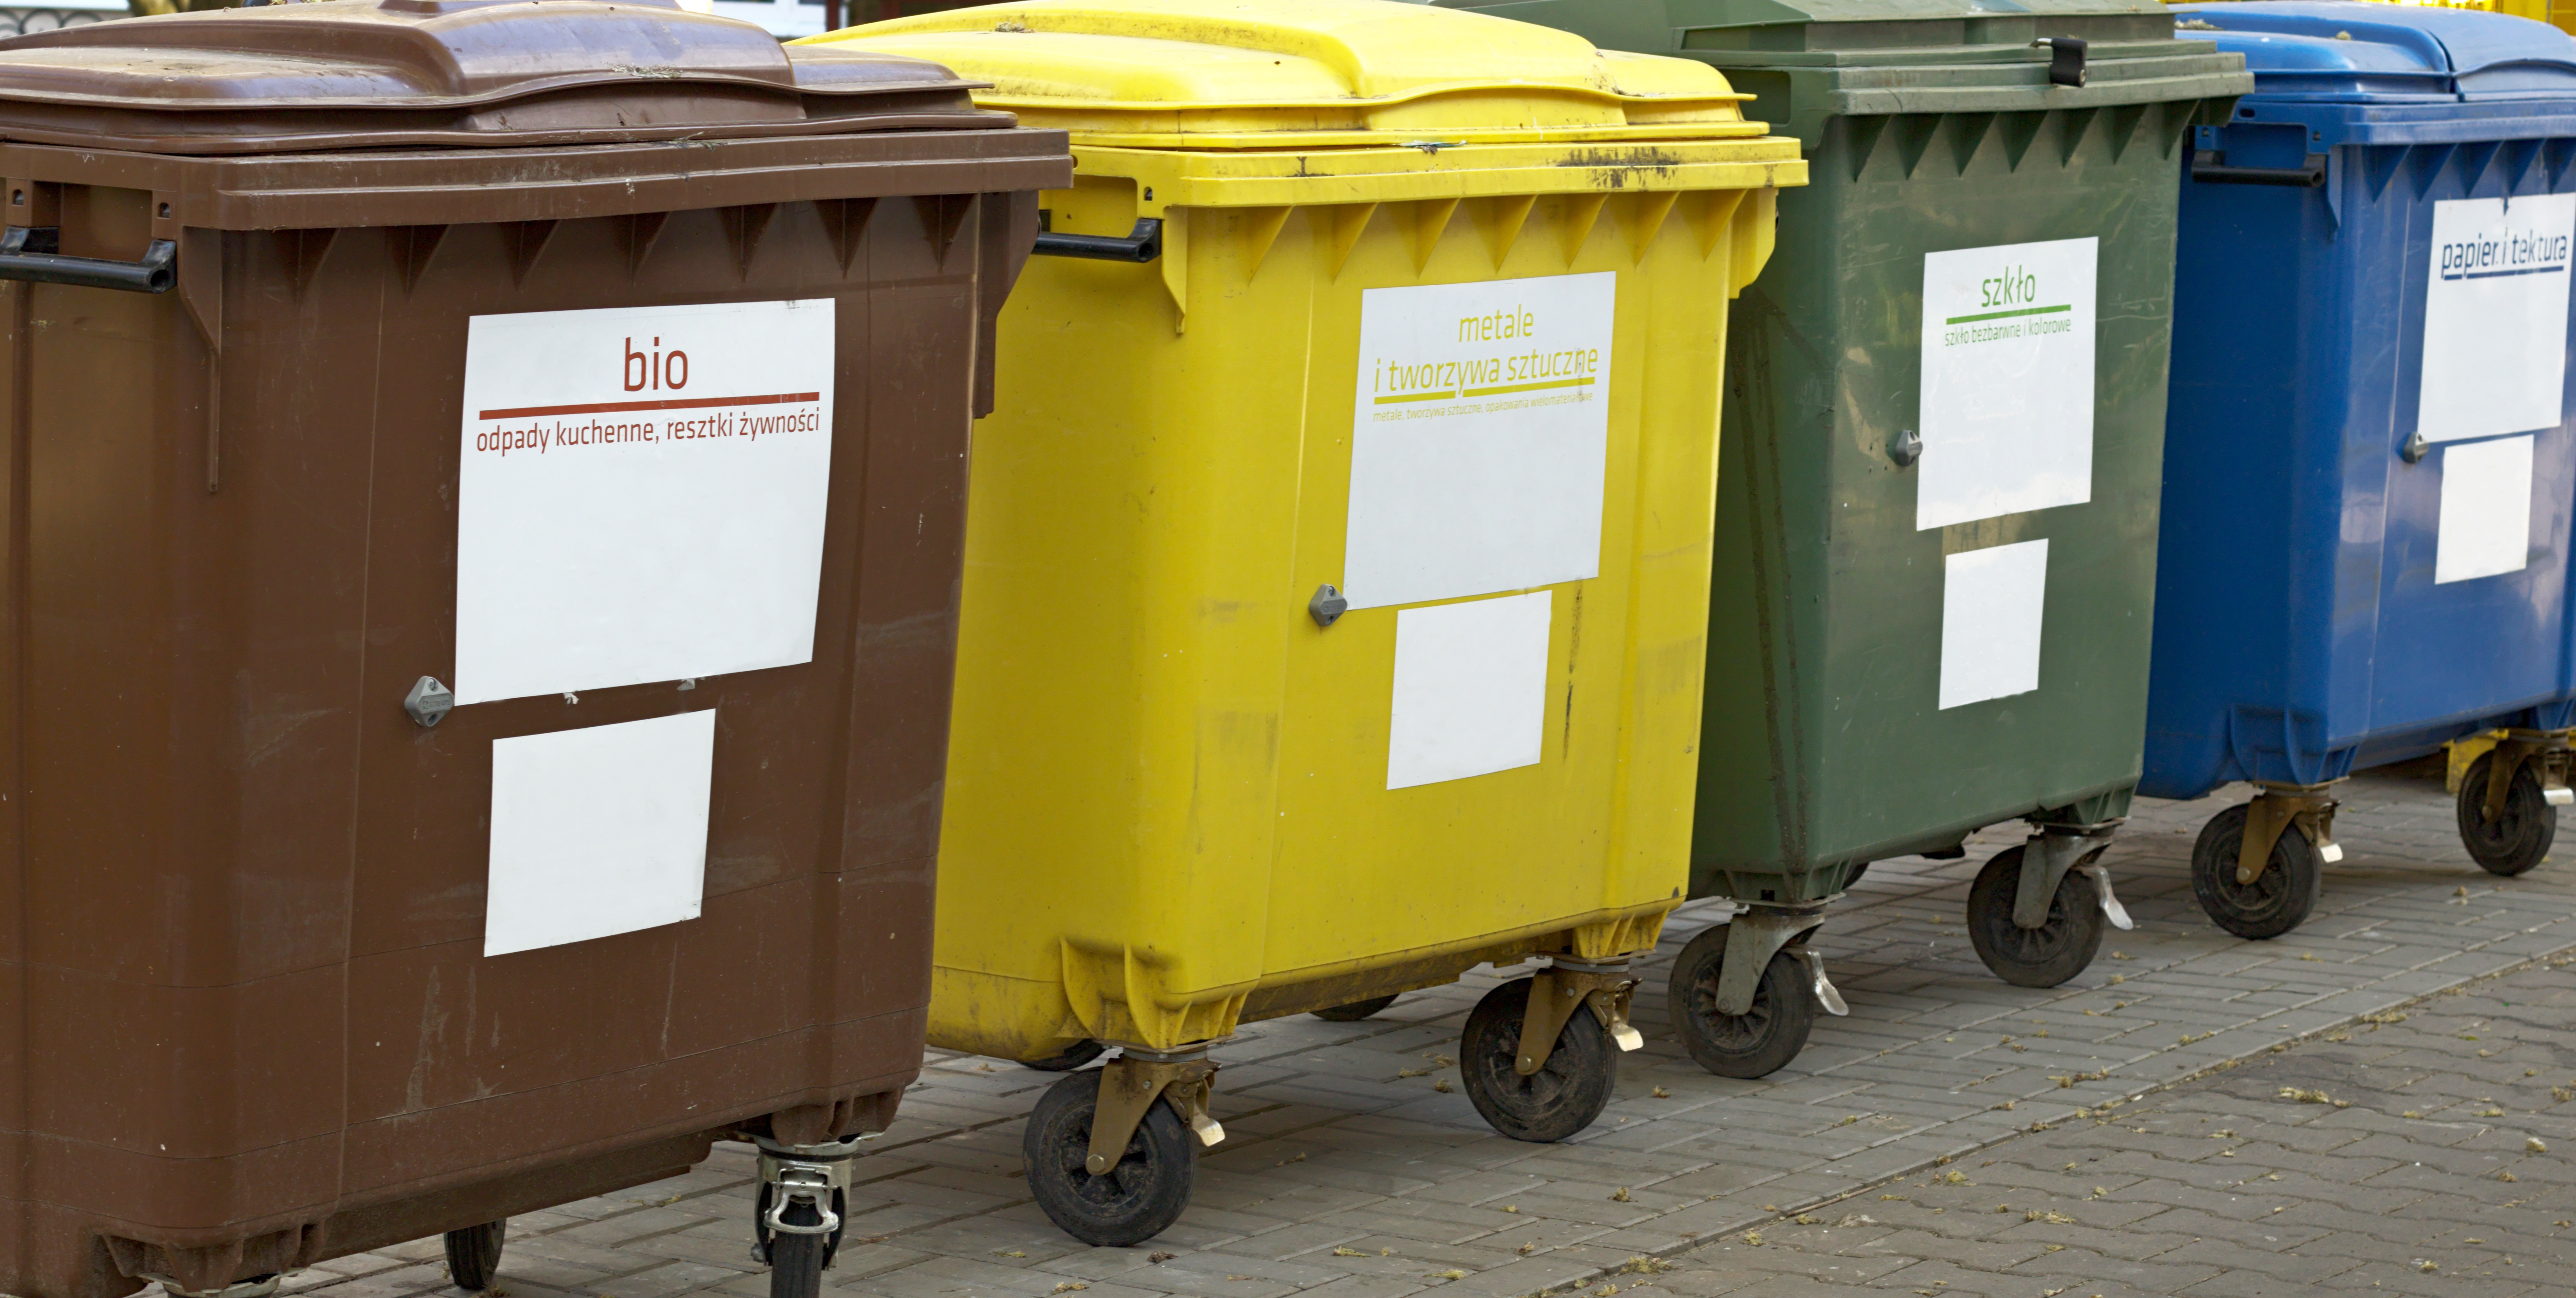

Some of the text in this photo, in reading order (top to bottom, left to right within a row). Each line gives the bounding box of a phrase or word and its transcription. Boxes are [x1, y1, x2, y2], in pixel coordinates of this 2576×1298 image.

[2441, 227, 2568, 279] papier i tektura
[1981, 265, 2035, 307] szkło
[1459, 304, 1533, 342] metale
[1945, 317, 2072, 346] szkło bezbarwne i kolorowe
[624, 337, 688, 392] bio
[1375, 348, 1598, 395] i tworzywa sztuczne
[1373, 408, 1404, 422] metale,
[1407, 407, 1445, 420] tworzywa
[1447, 403, 1483, 415] sztuczne,
[1485, 397, 1529, 414] opakowania
[477, 407, 819, 457] odpady kuchenne, resztki żywności
